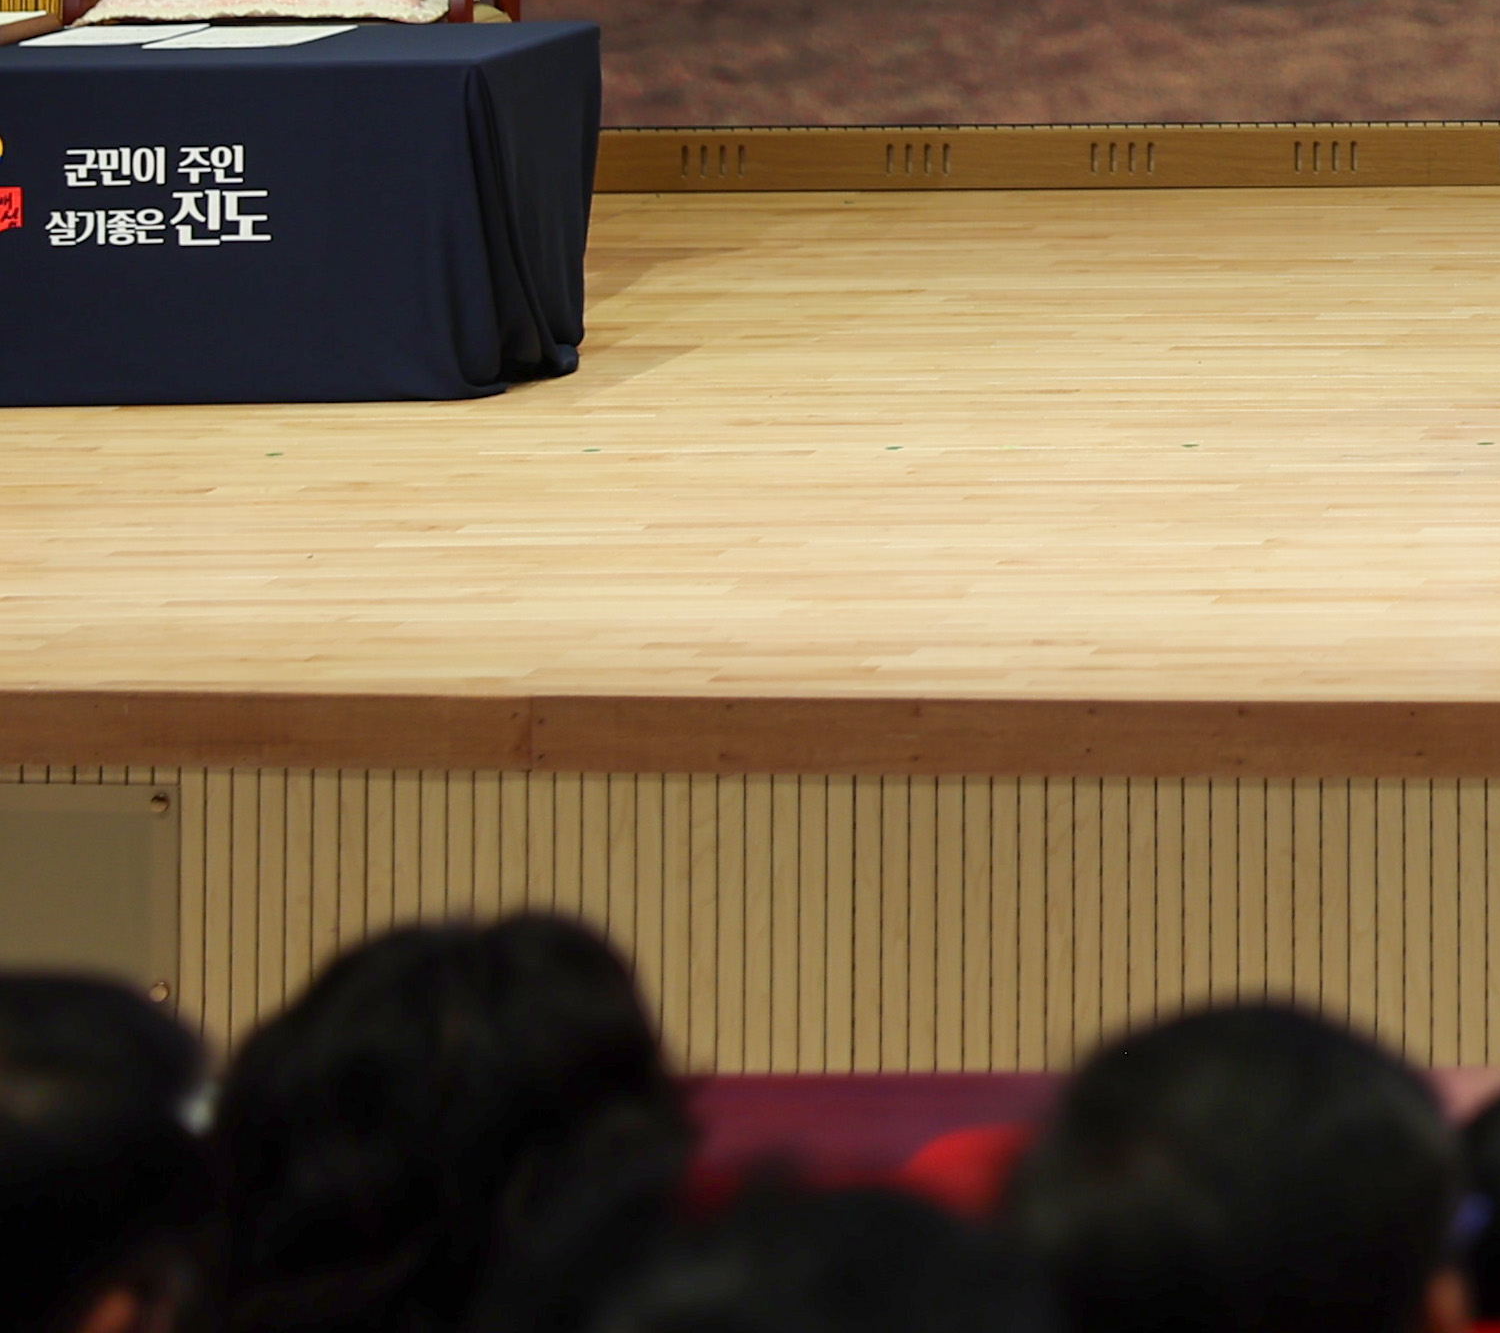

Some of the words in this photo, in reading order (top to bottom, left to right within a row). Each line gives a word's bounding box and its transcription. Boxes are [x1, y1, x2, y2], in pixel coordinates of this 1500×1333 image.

[63, 145, 165, 188] 군민이
[177, 144, 245, 185] 주인
[45, 208, 165, 247] 살기좋은
[171, 189, 272, 247] 진도
